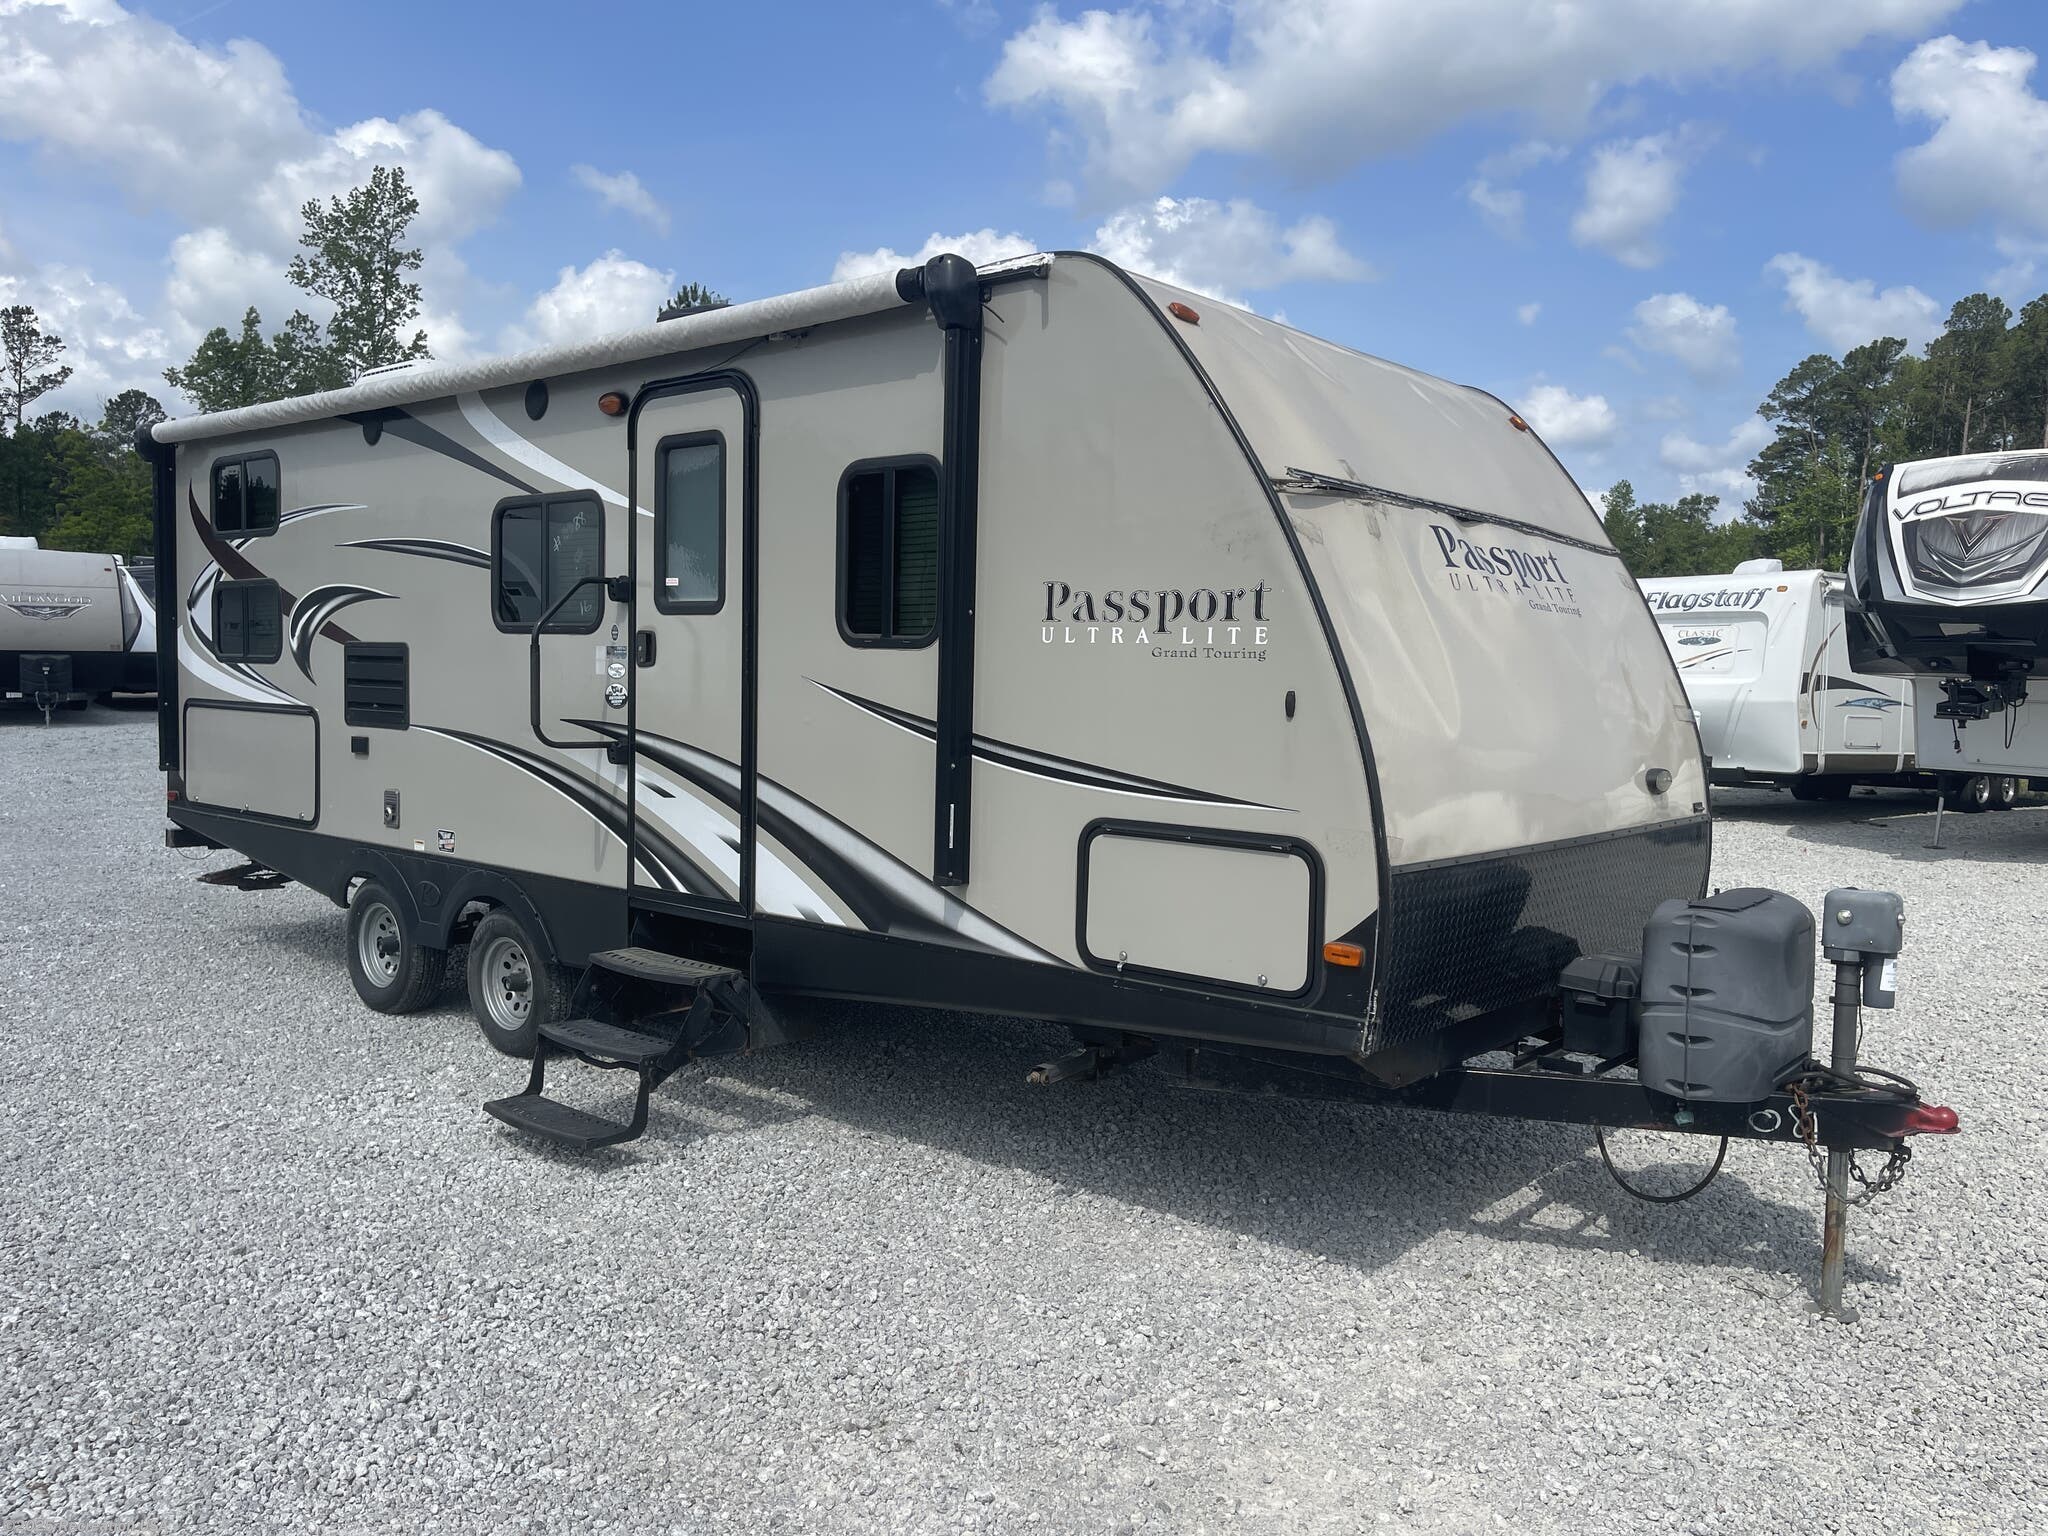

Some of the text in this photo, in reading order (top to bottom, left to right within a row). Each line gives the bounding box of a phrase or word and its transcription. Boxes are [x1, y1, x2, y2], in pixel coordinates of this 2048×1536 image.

[1429, 525, 1569, 588] Passport
[1450, 573, 1577, 604] ULTRA LITE
[1646, 587, 1772, 611] Flagstaff
[1041, 578, 1272, 634] Passport
[1529, 600, 1582, 618] Grand Touring
[1041, 626, 1269, 645] ULTRA LITE
[1678, 629, 1724, 637] CLASSIC
[1151, 647, 1267, 662] Grand Touring
